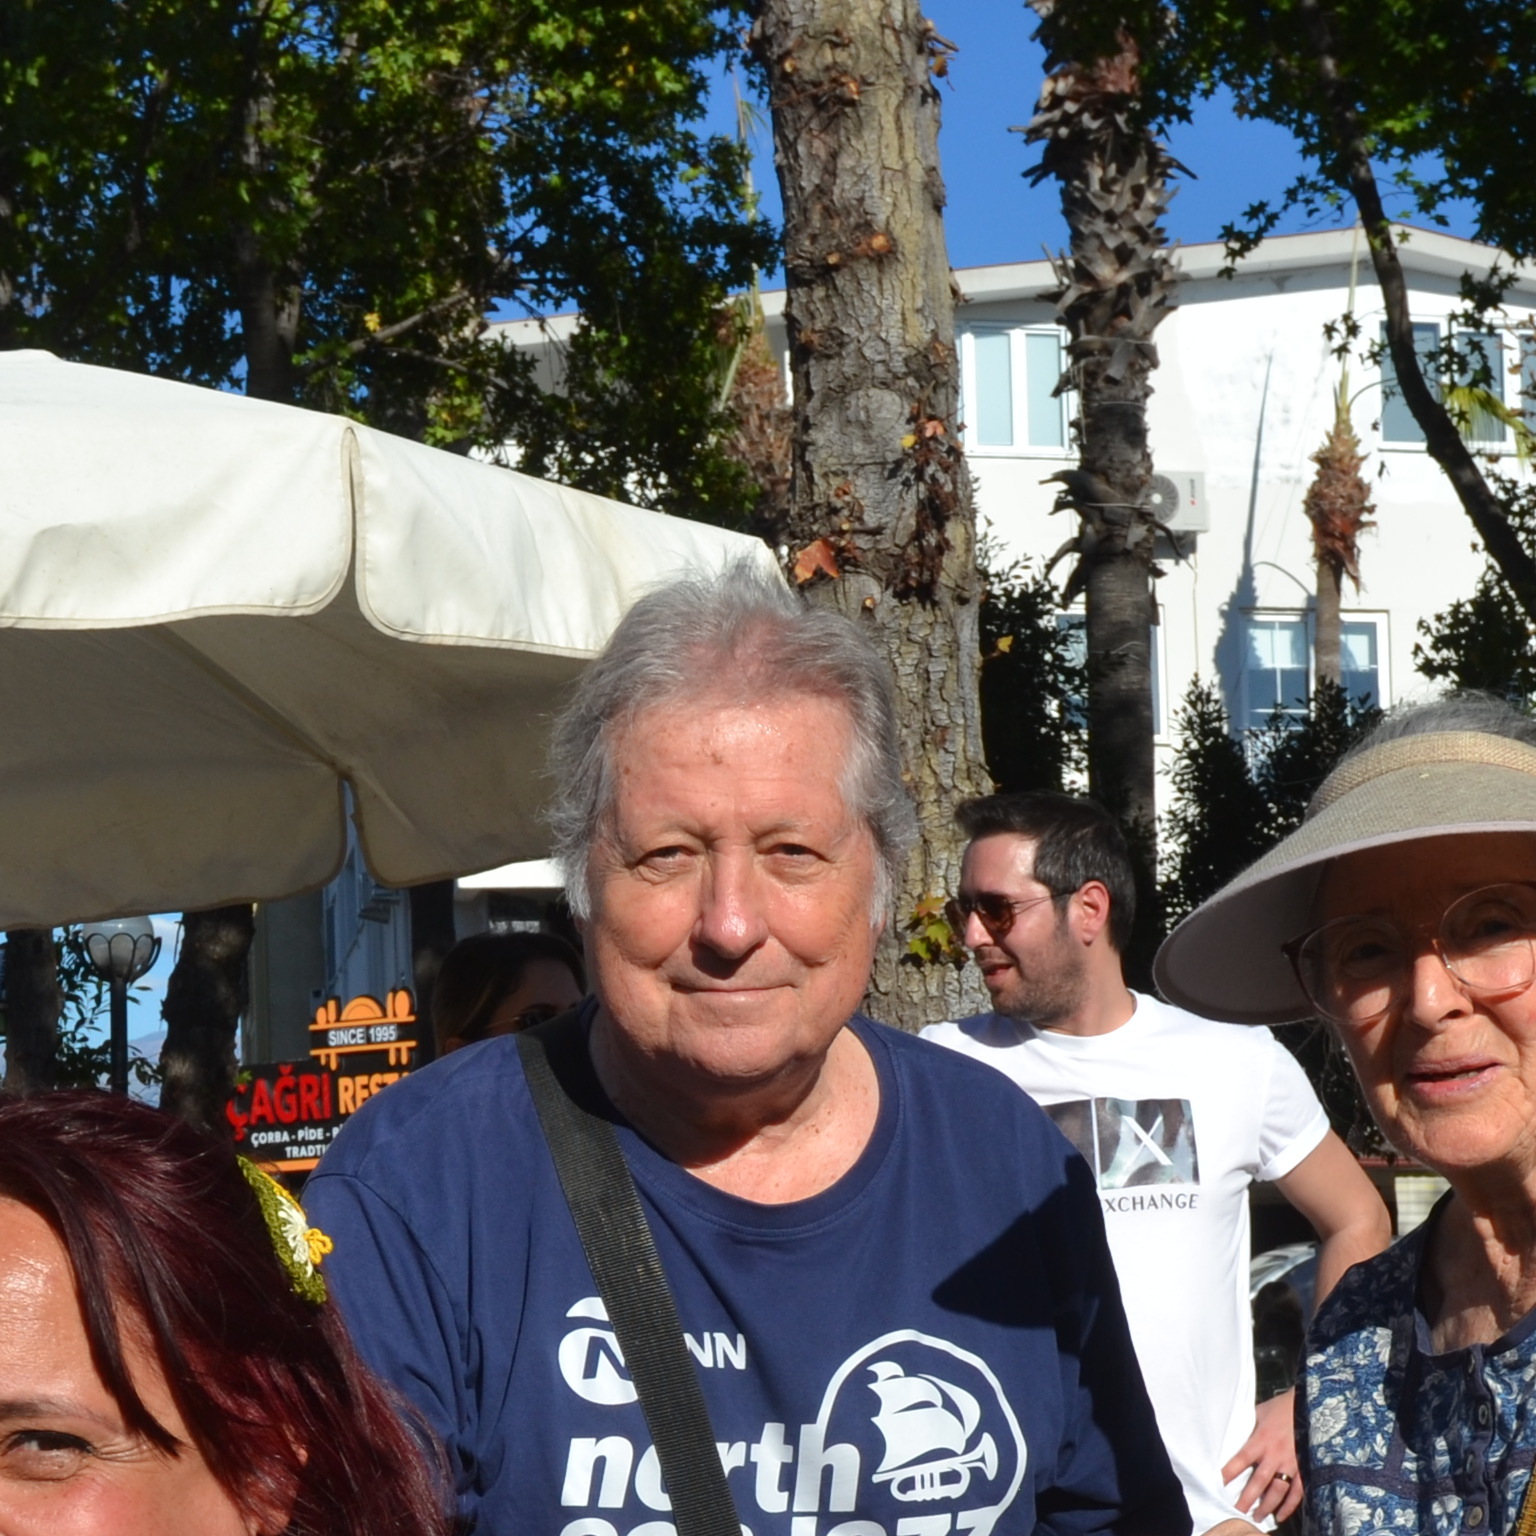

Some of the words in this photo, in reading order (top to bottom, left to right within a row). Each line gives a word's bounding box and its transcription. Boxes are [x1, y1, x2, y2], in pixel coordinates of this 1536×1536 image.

[328, 1027, 365, 1046] SINCE
[369, 1024, 397, 1042] 1995
[251, 1130, 290, 1148] ÇORBA
[297, 1126, 324, 1141] PİDE
[1105, 1193, 1199, 1213] XCHANGE
